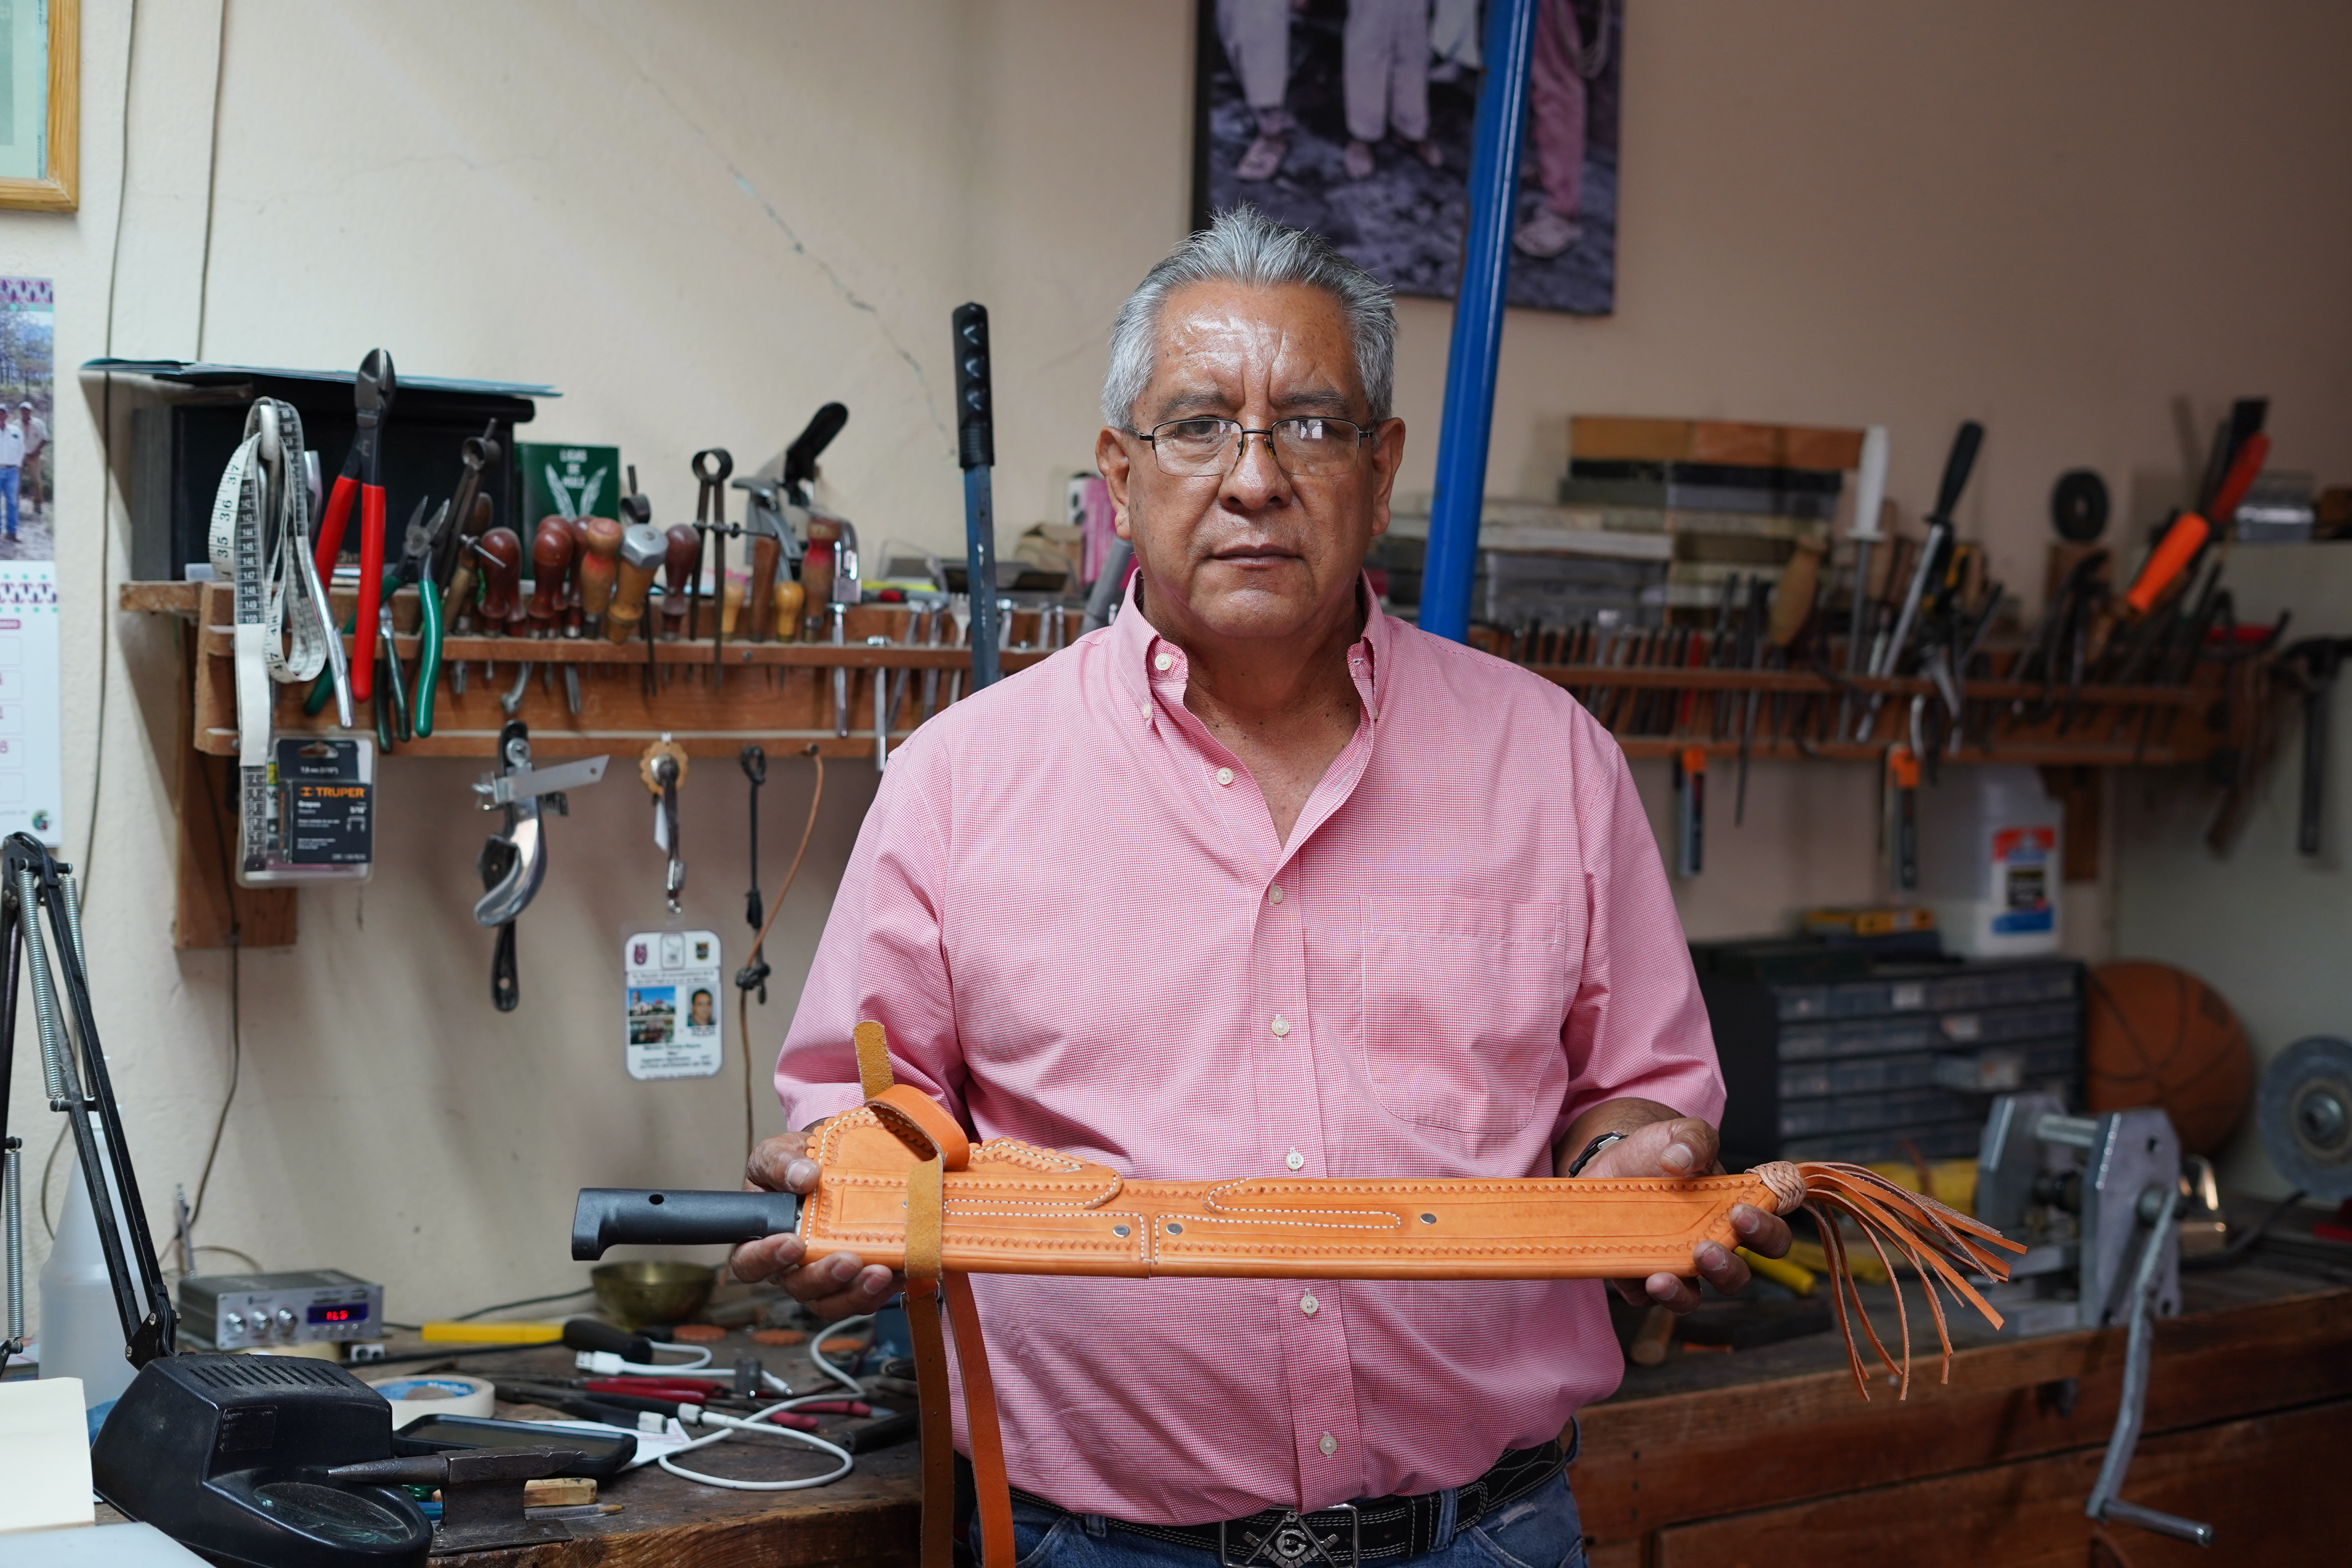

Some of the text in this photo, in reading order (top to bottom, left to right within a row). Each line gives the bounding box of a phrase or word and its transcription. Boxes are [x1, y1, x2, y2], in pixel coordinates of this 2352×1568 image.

[220, 500, 232, 521] 36
[217, 536, 229, 558] 35
[243, 571, 256, 579] 147
[244, 600, 257, 609] 149
[245, 615, 258, 623] 150
[316, 787, 365, 798] TRUPER
